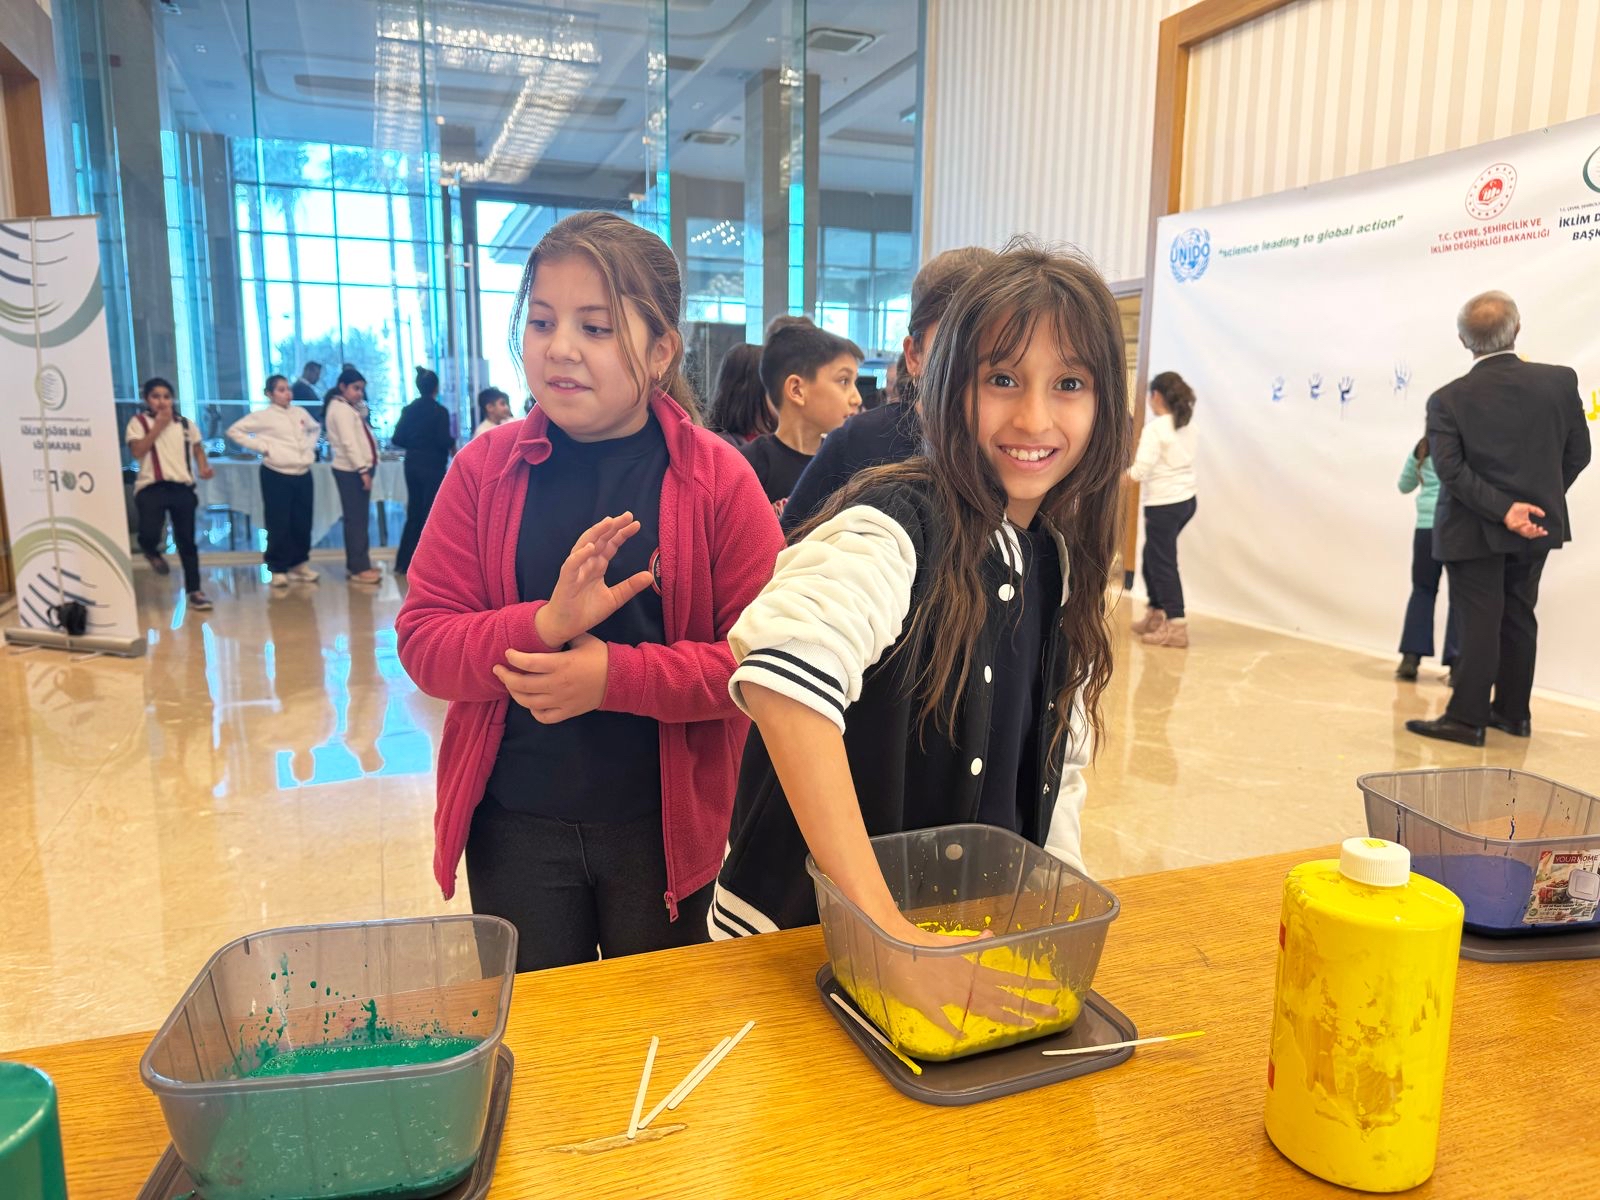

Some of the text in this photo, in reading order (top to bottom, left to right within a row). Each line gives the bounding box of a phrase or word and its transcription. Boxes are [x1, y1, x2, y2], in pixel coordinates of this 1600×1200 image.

[1483, 219, 1529, 236] ŞEHİRCİLİK
[1530, 217, 1542, 228] VE
[1559, 213, 1590, 228] İKLİM
[1261, 236, 1300, 248] leading
[1303, 233, 1315, 244] to
[1317, 224, 1354, 244] global
[1430, 228, 1550, 255] İKLİM DEĞİŞİKLİĞİ BAKANLIĞI
[1170, 242, 1210, 265] UNIDO
